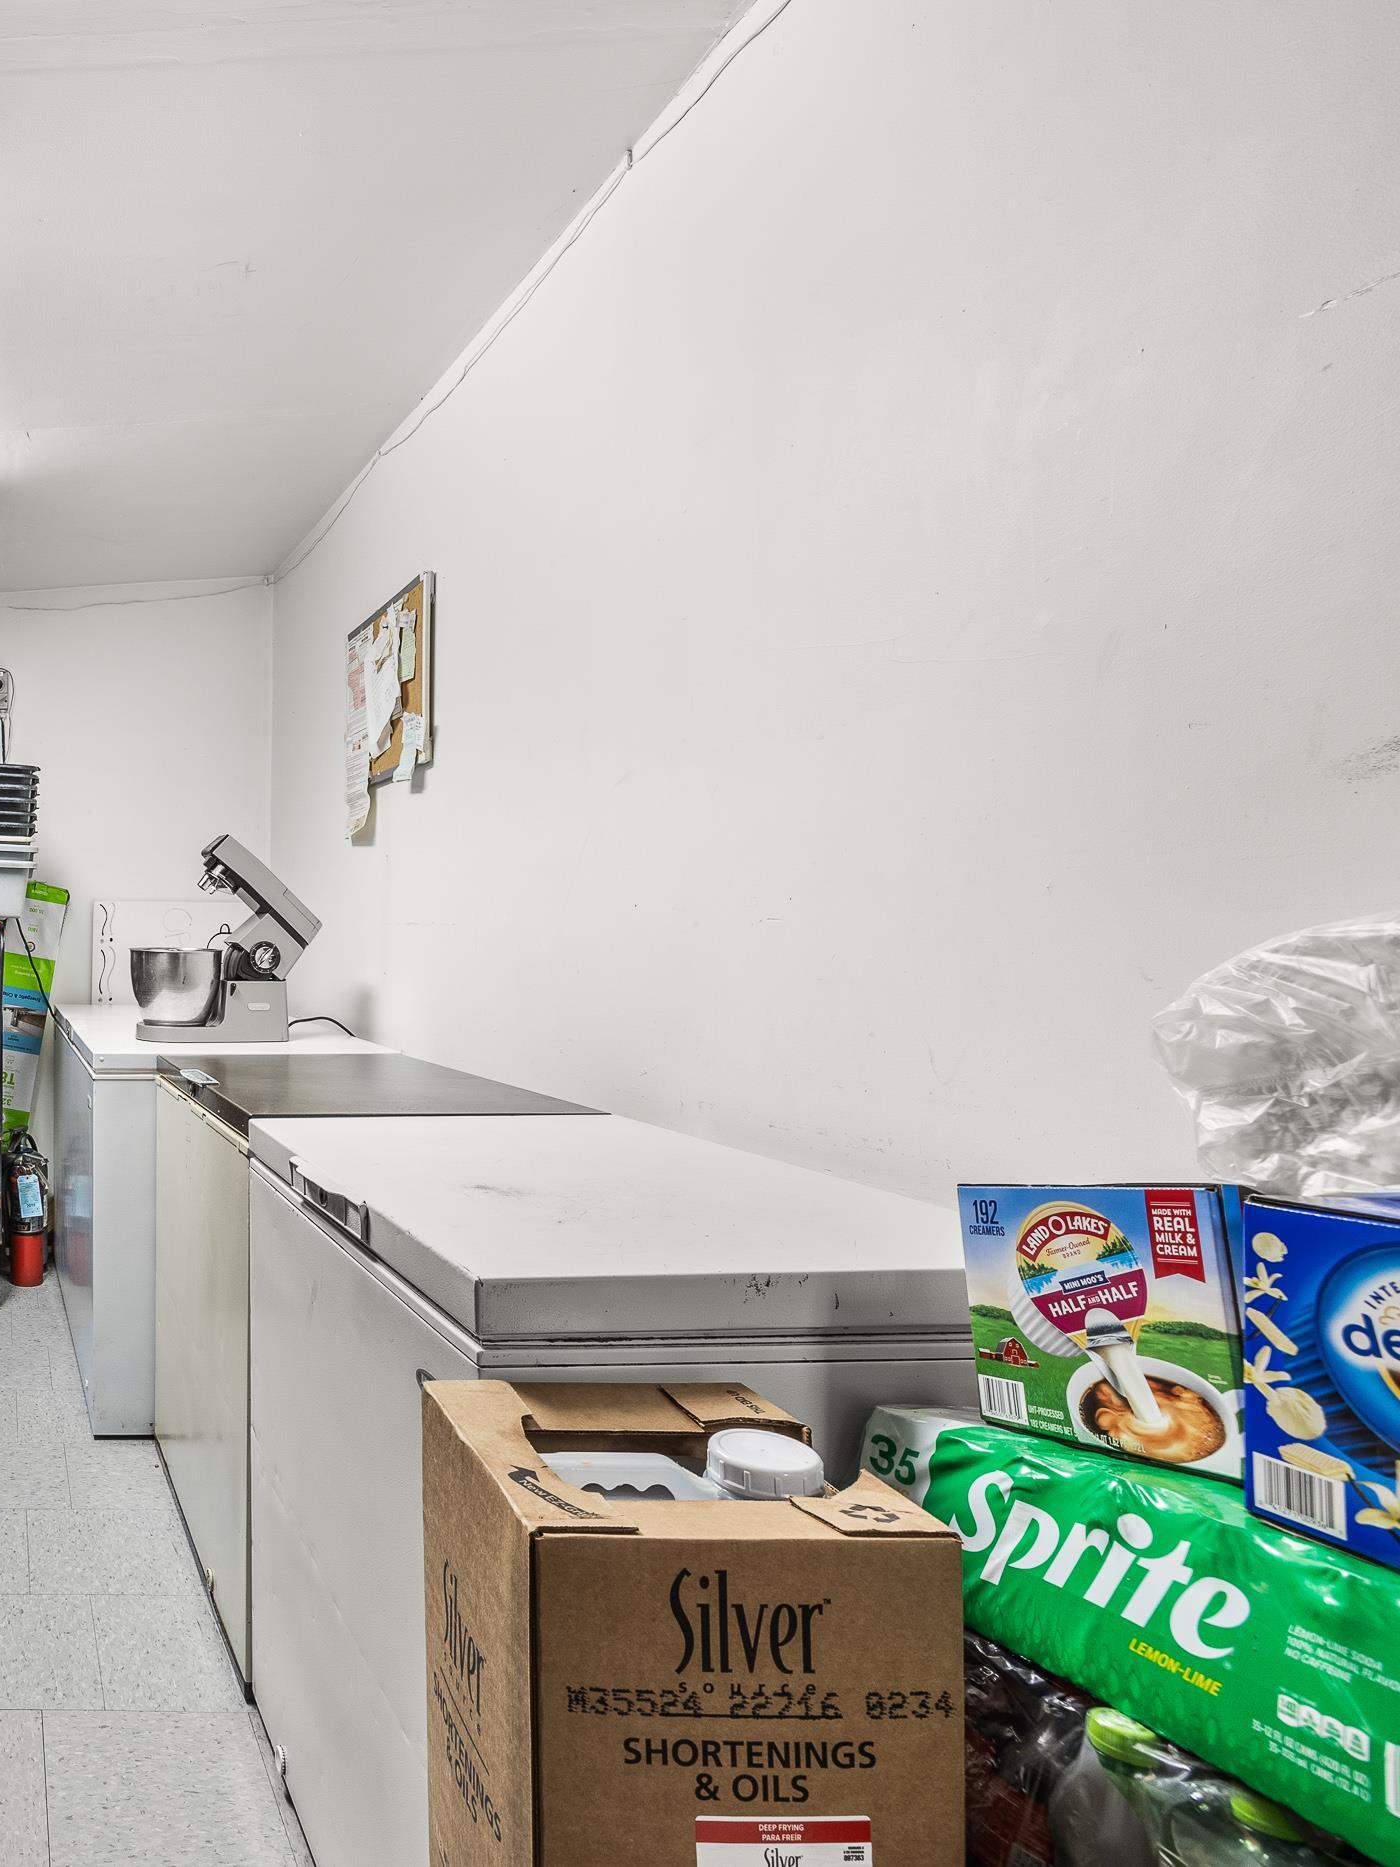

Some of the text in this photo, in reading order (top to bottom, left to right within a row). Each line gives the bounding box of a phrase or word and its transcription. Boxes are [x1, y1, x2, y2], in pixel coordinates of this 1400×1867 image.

[972, 1200, 1000, 1225] 192
[1151, 1208, 1192, 1216] MADE WITH
[969, 1225, 1005, 1236] CREAMERS
[1153, 1216, 1195, 1233] REAL
[1022, 1215, 1108, 1256] LAND O LAKES
[1155, 1233, 1196, 1244] MILK &
[1156, 1244, 1198, 1257] CREAM
[1063, 1274, 1104, 1292] MINI MOO'S
[1048, 1281, 1139, 1317] HALF AND HALF
[1027, 1404, 1064, 1420] UHT-PROCESSED
[1038, 1420, 1064, 1434] CREAMERS
[1063, 1427, 1073, 1436] NET
[869, 1433, 920, 1486] 35
[518, 1479, 543, 1496] New
[948, 1469, 1251, 1660] Sprite
[669, 1567, 824, 1675] Silver
[442, 1557, 486, 1717] Silver
[1128, 1637, 1223, 1697] LEMON-LIME
[678, 1681, 817, 1696] source
[433, 1671, 502, 1843] SHORTENINGS
[623, 1737, 877, 1769] SHORTENINGS
[453, 1758, 478, 1824] OILS
[695, 1773, 810, 1803] & OILS
[758, 1823, 804, 1832] DEEP FRYING
[761, 1832, 802, 1842] PARA FREÍR
[763, 1847, 802, 1867] Silver
